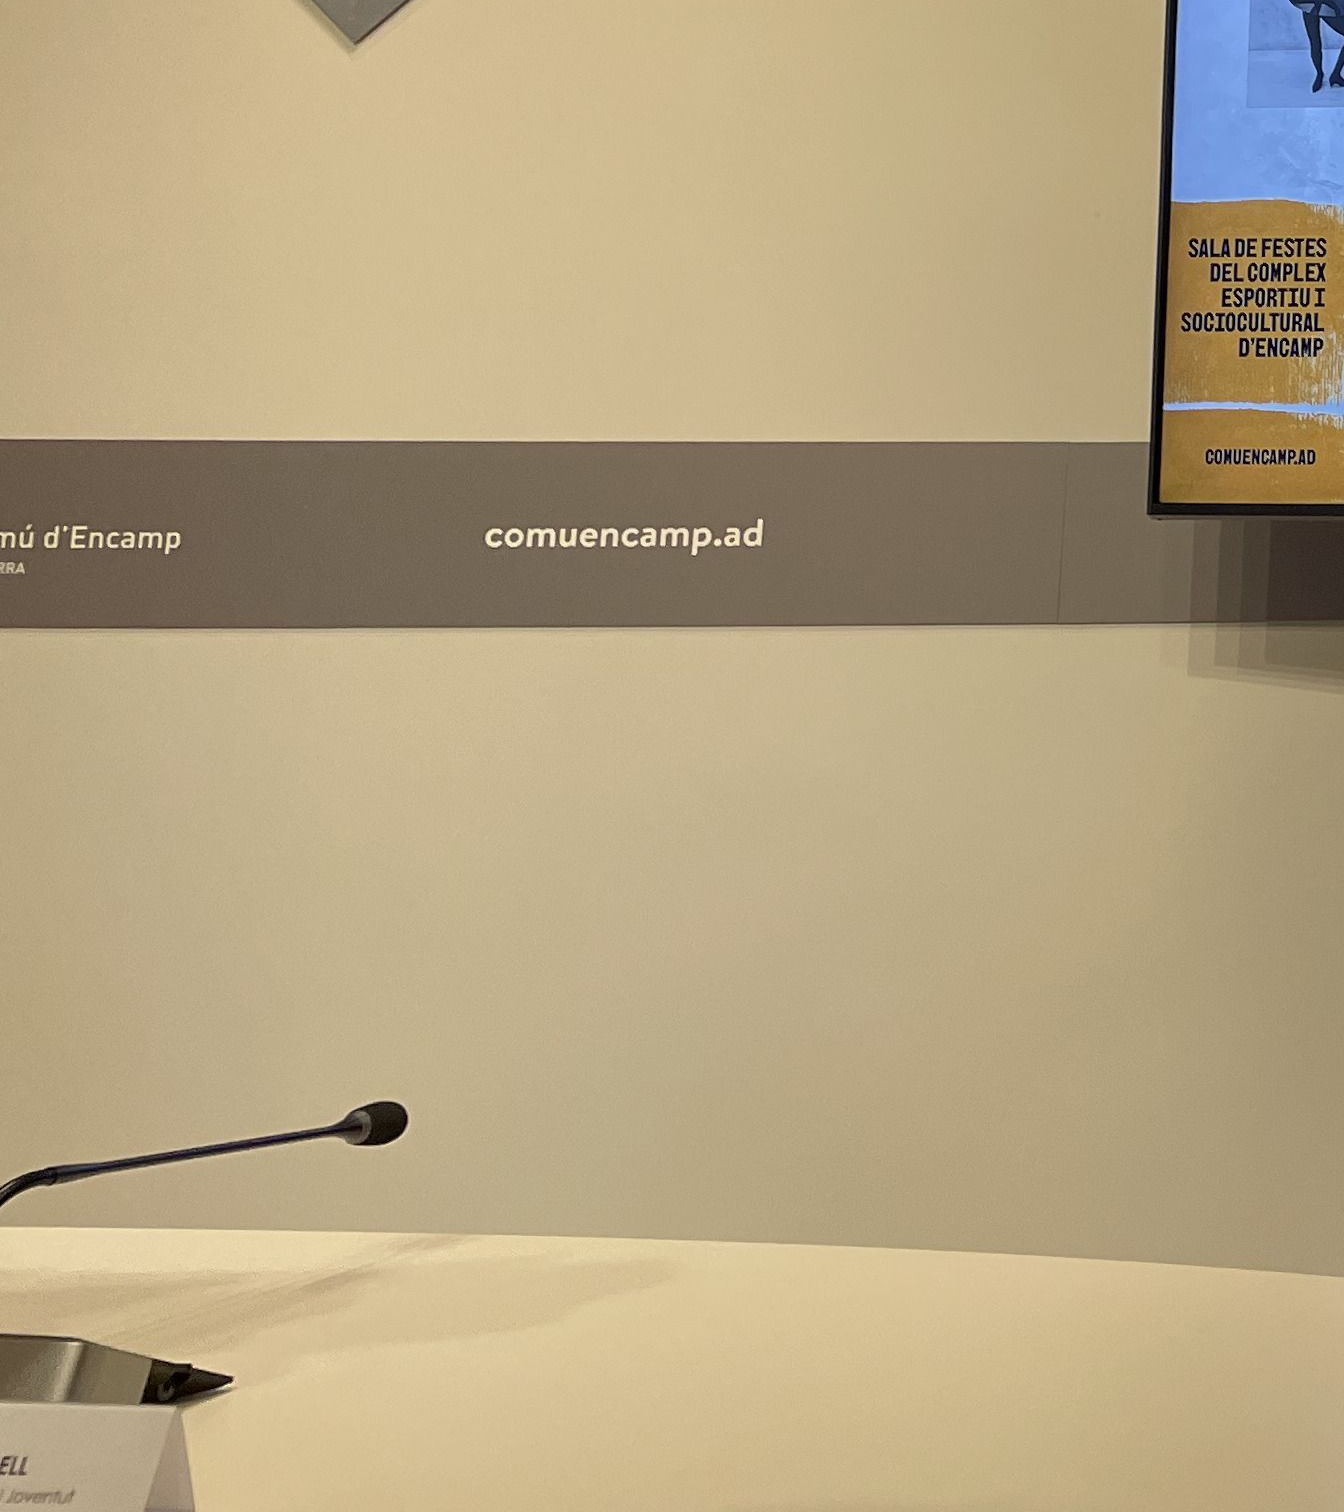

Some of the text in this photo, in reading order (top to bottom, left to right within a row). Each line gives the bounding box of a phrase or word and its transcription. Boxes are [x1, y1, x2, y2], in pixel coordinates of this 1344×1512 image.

[1189, 238, 1327, 258] SALA DE FESTES
[1210, 263, 1326, 282] DEL COMPLEX
[1222, 288, 1325, 307] ESPORTIU I
[1181, 312, 1324, 332] SOCIOCULTURAL
[1239, 338, 1324, 357] D'ENCAMP
[1205, 449, 1316, 465] COMUENCAMP.AD
[44, 525, 182, 555] d'Encamp
[484, 518, 764, 556] comuencamp.ad
